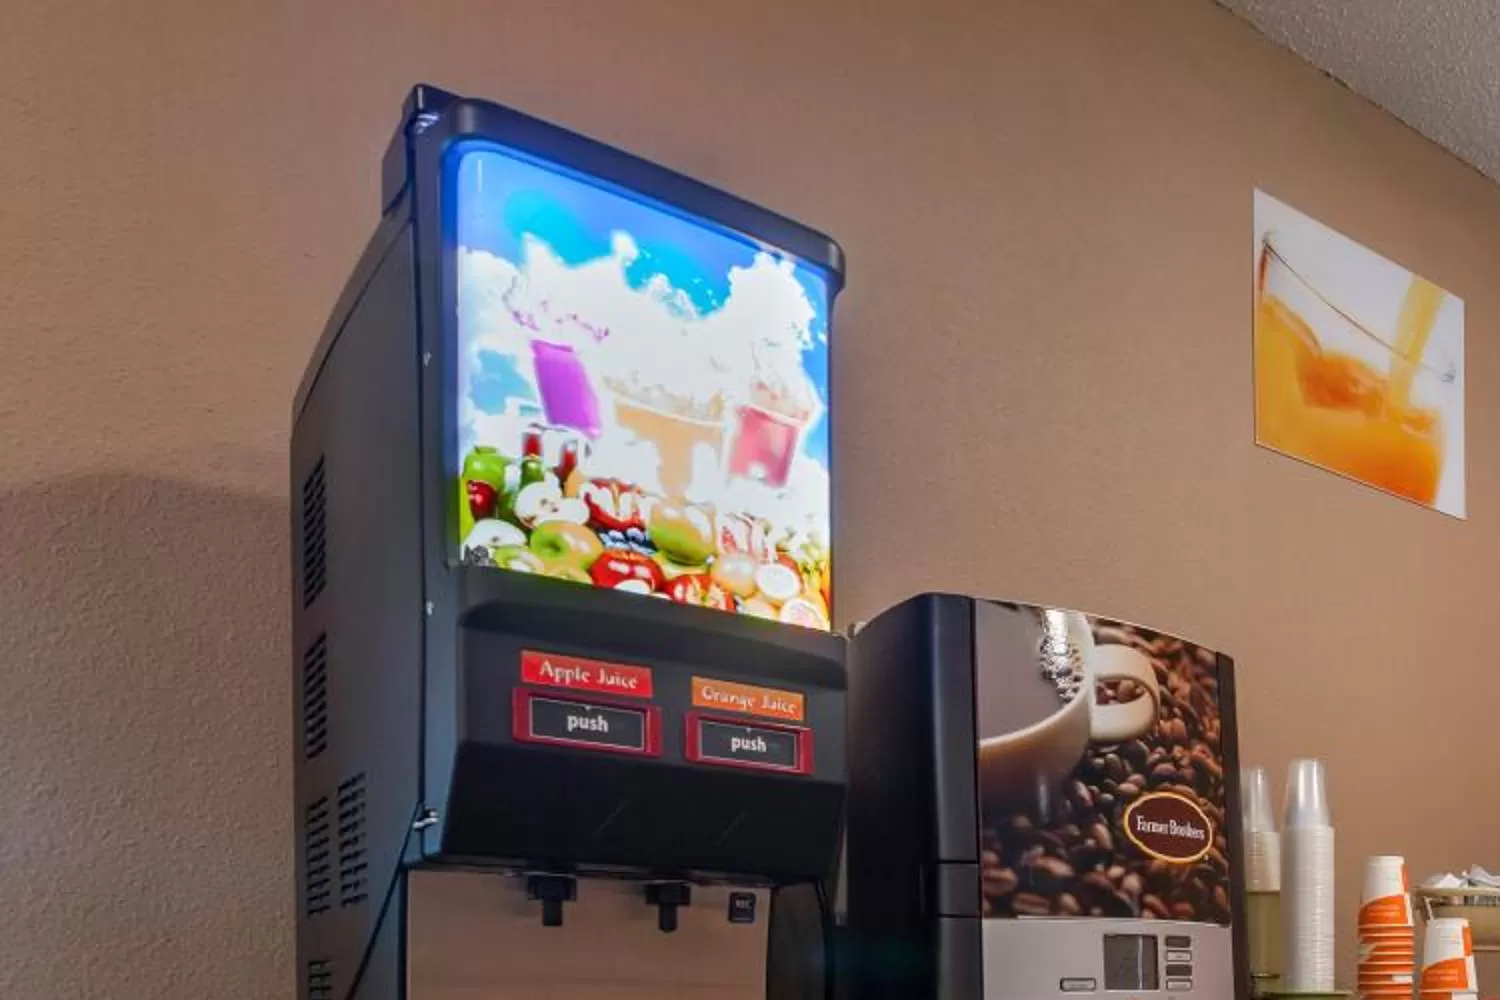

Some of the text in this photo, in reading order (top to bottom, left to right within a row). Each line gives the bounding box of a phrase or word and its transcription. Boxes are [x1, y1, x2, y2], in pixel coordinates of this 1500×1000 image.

[539, 660, 638, 689] Apple Juice
[701, 685, 797, 714] Orange Juice
[567, 715, 609, 733] push
[731, 736, 769, 753] push
